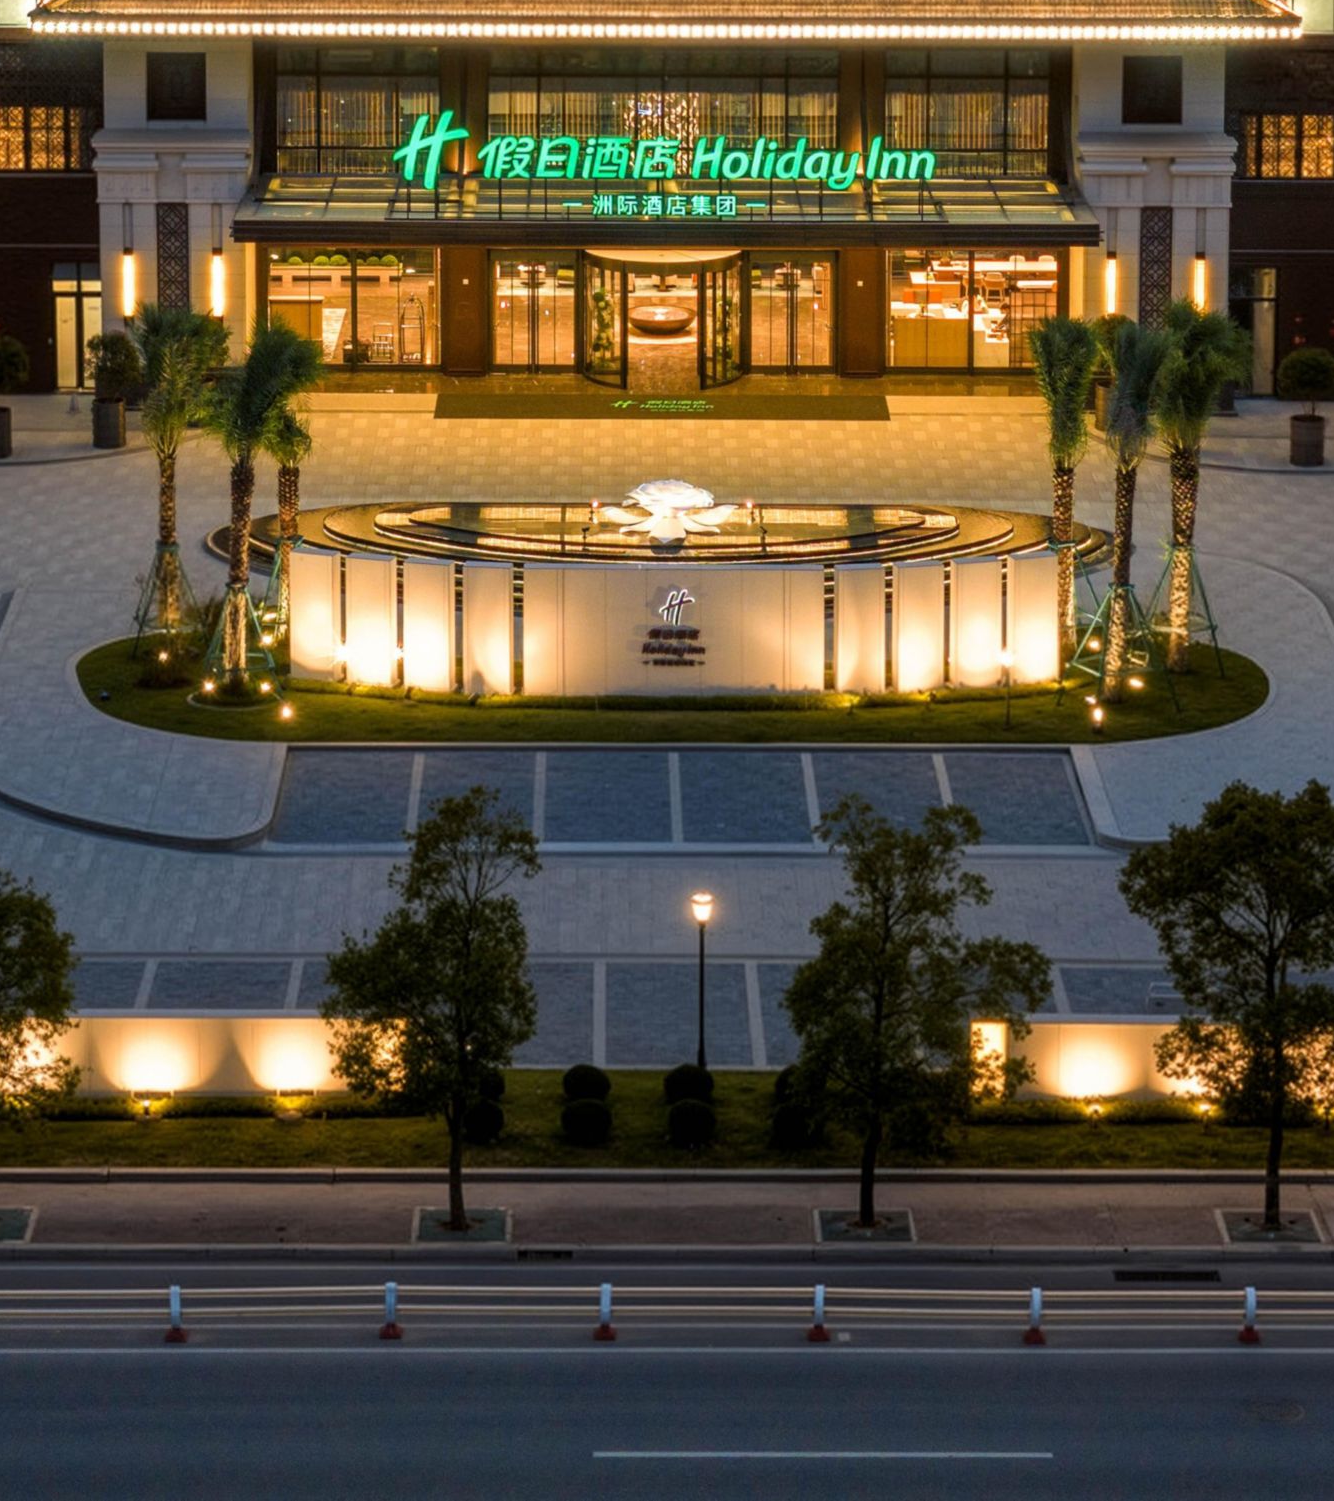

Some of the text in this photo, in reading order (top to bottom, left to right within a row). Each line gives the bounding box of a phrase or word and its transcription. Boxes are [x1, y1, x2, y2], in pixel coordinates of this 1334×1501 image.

[477, 135, 681, 180] 假日酒店
[691, 135, 861, 190] Holiday
[865, 135, 936, 180] Inn
[592, 194, 737, 217] 洲际酒店集团
